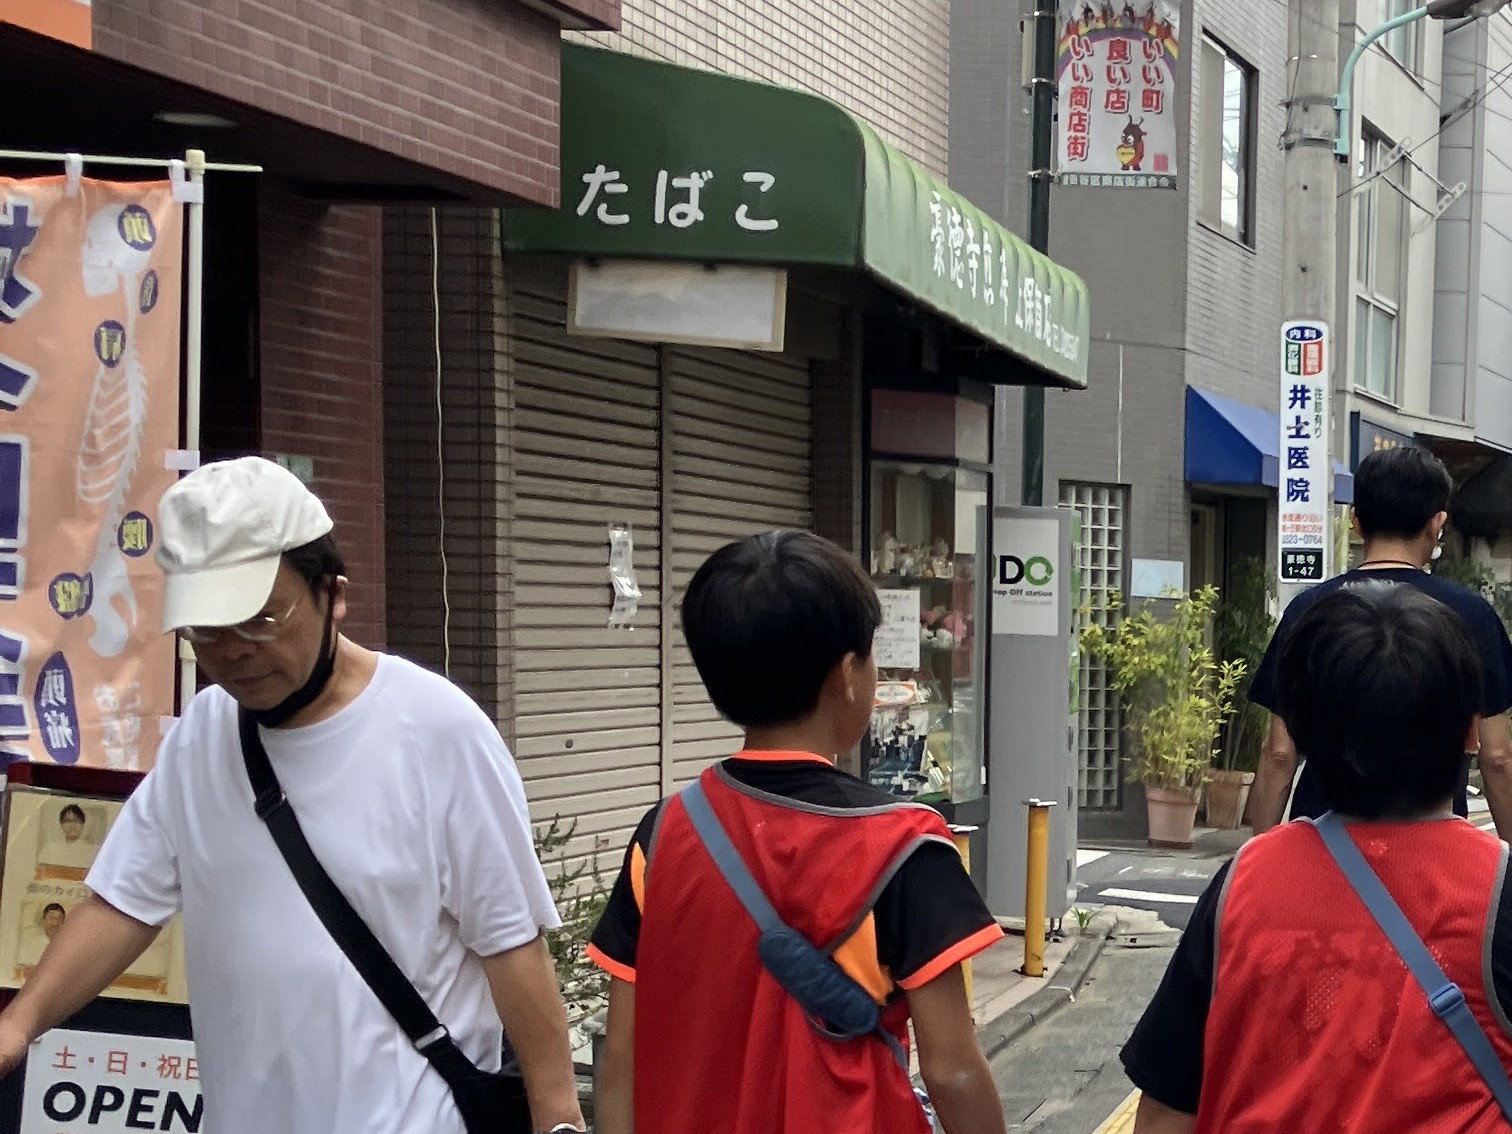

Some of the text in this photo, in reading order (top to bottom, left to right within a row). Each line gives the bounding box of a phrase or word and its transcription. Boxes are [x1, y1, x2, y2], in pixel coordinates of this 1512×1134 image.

[1066, 34, 1094, 161] いい商店街
[1105, 37, 1131, 113] 良い店
[1141, 37, 1165, 114] いい町
[576, 164, 779, 231] たばこ
[1288, 328, 1317, 340] 内科
[1288, 566, 1315, 577] 1-47
[42, 1080, 204, 1134] OPEN
